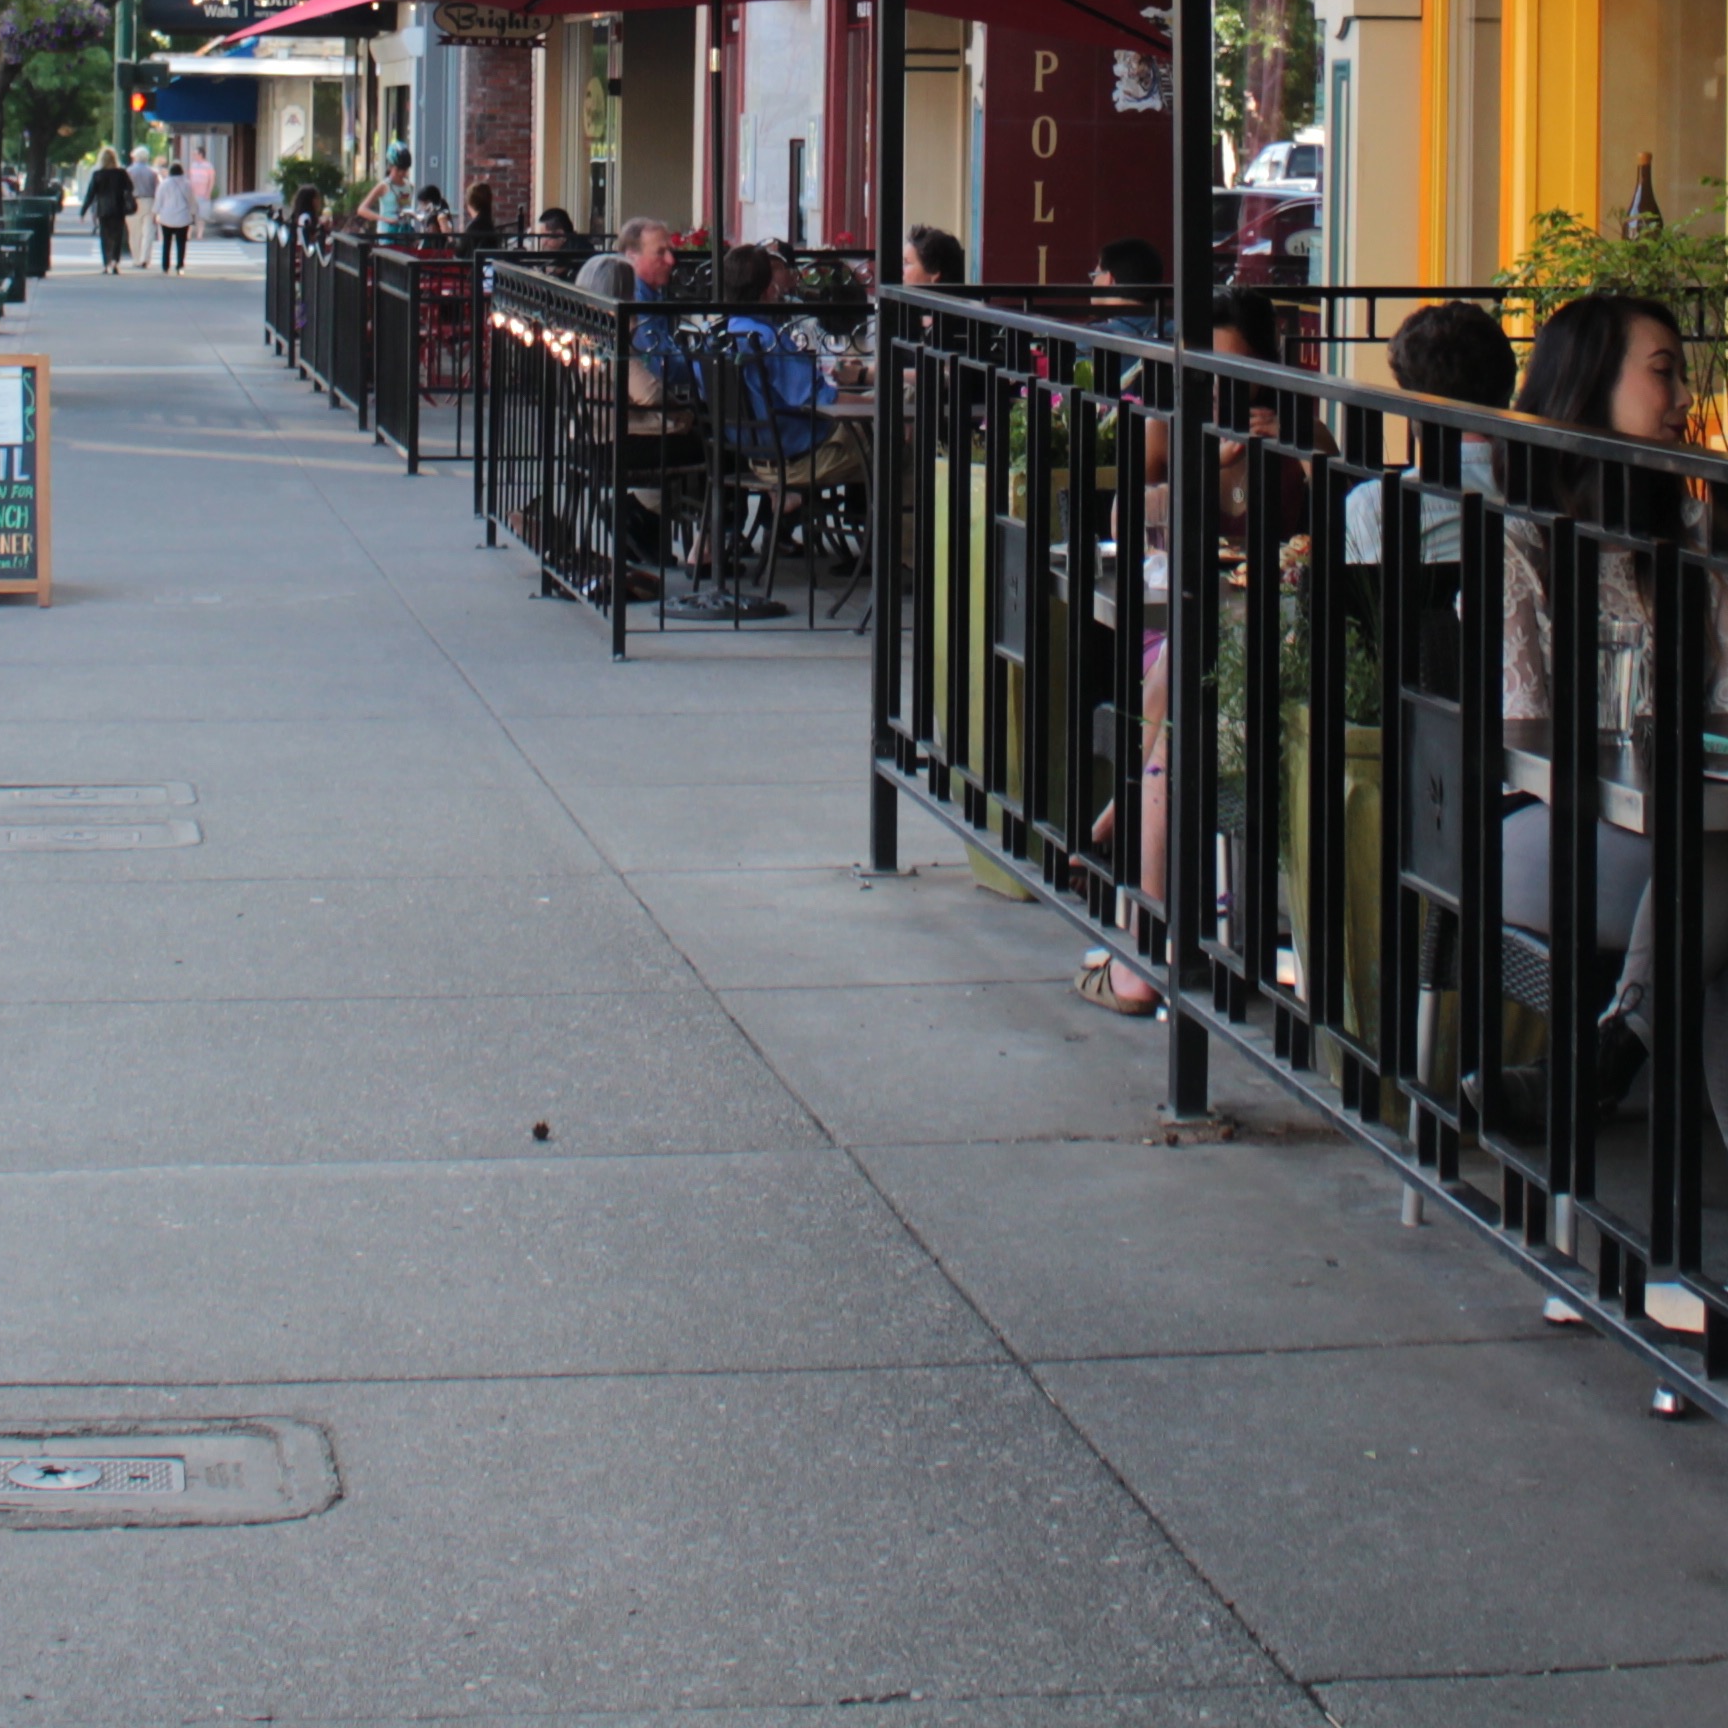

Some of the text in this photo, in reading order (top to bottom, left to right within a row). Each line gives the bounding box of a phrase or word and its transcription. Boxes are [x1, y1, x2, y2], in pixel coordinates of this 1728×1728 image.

[204, 4, 239, 18] Walla
[452, 37, 534, 46] CANDIES
[11, 484, 33, 500] FOR
